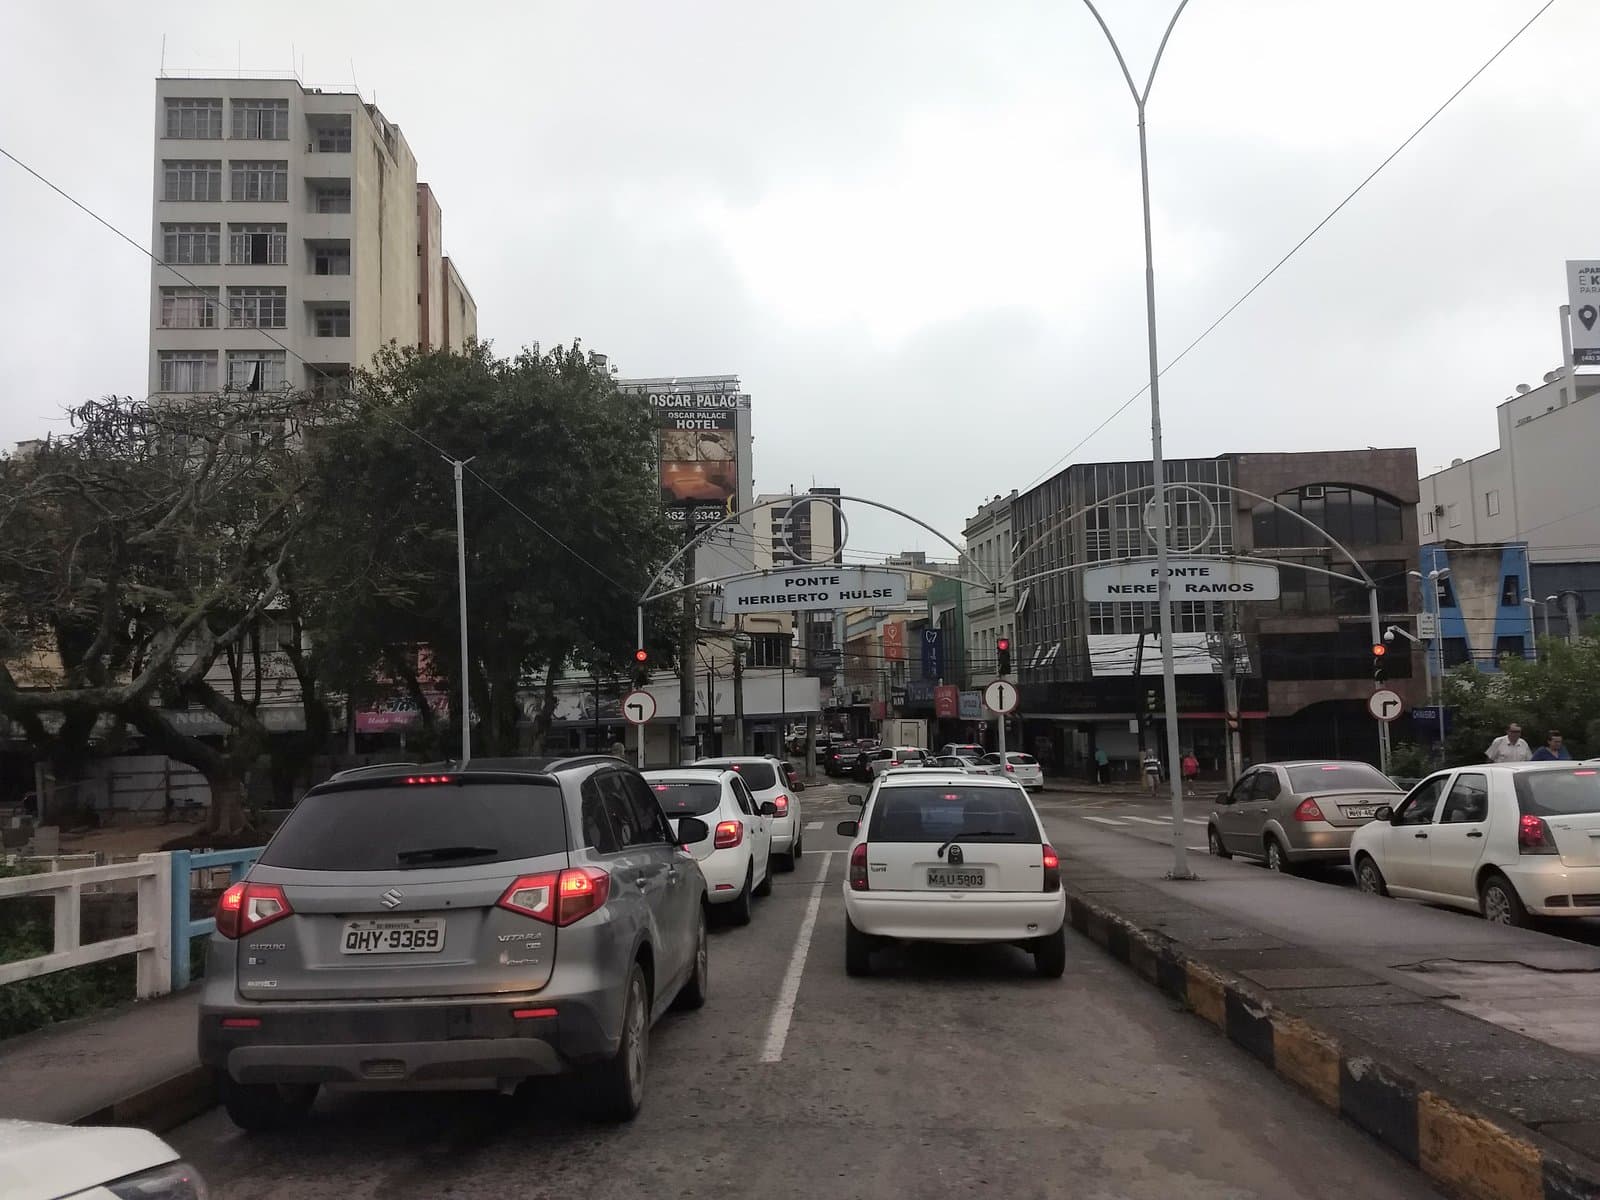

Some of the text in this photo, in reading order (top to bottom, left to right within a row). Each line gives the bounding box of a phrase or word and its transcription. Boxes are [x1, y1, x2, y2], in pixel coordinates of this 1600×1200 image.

[649, 394, 744, 407] OSCAR PALACE
[676, 419, 719, 429] HOTEL
[785, 576, 840, 587] PONTE
[1107, 583, 1254, 594] NERE RAMOS
[738, 592, 829, 605] HERIBERTO
